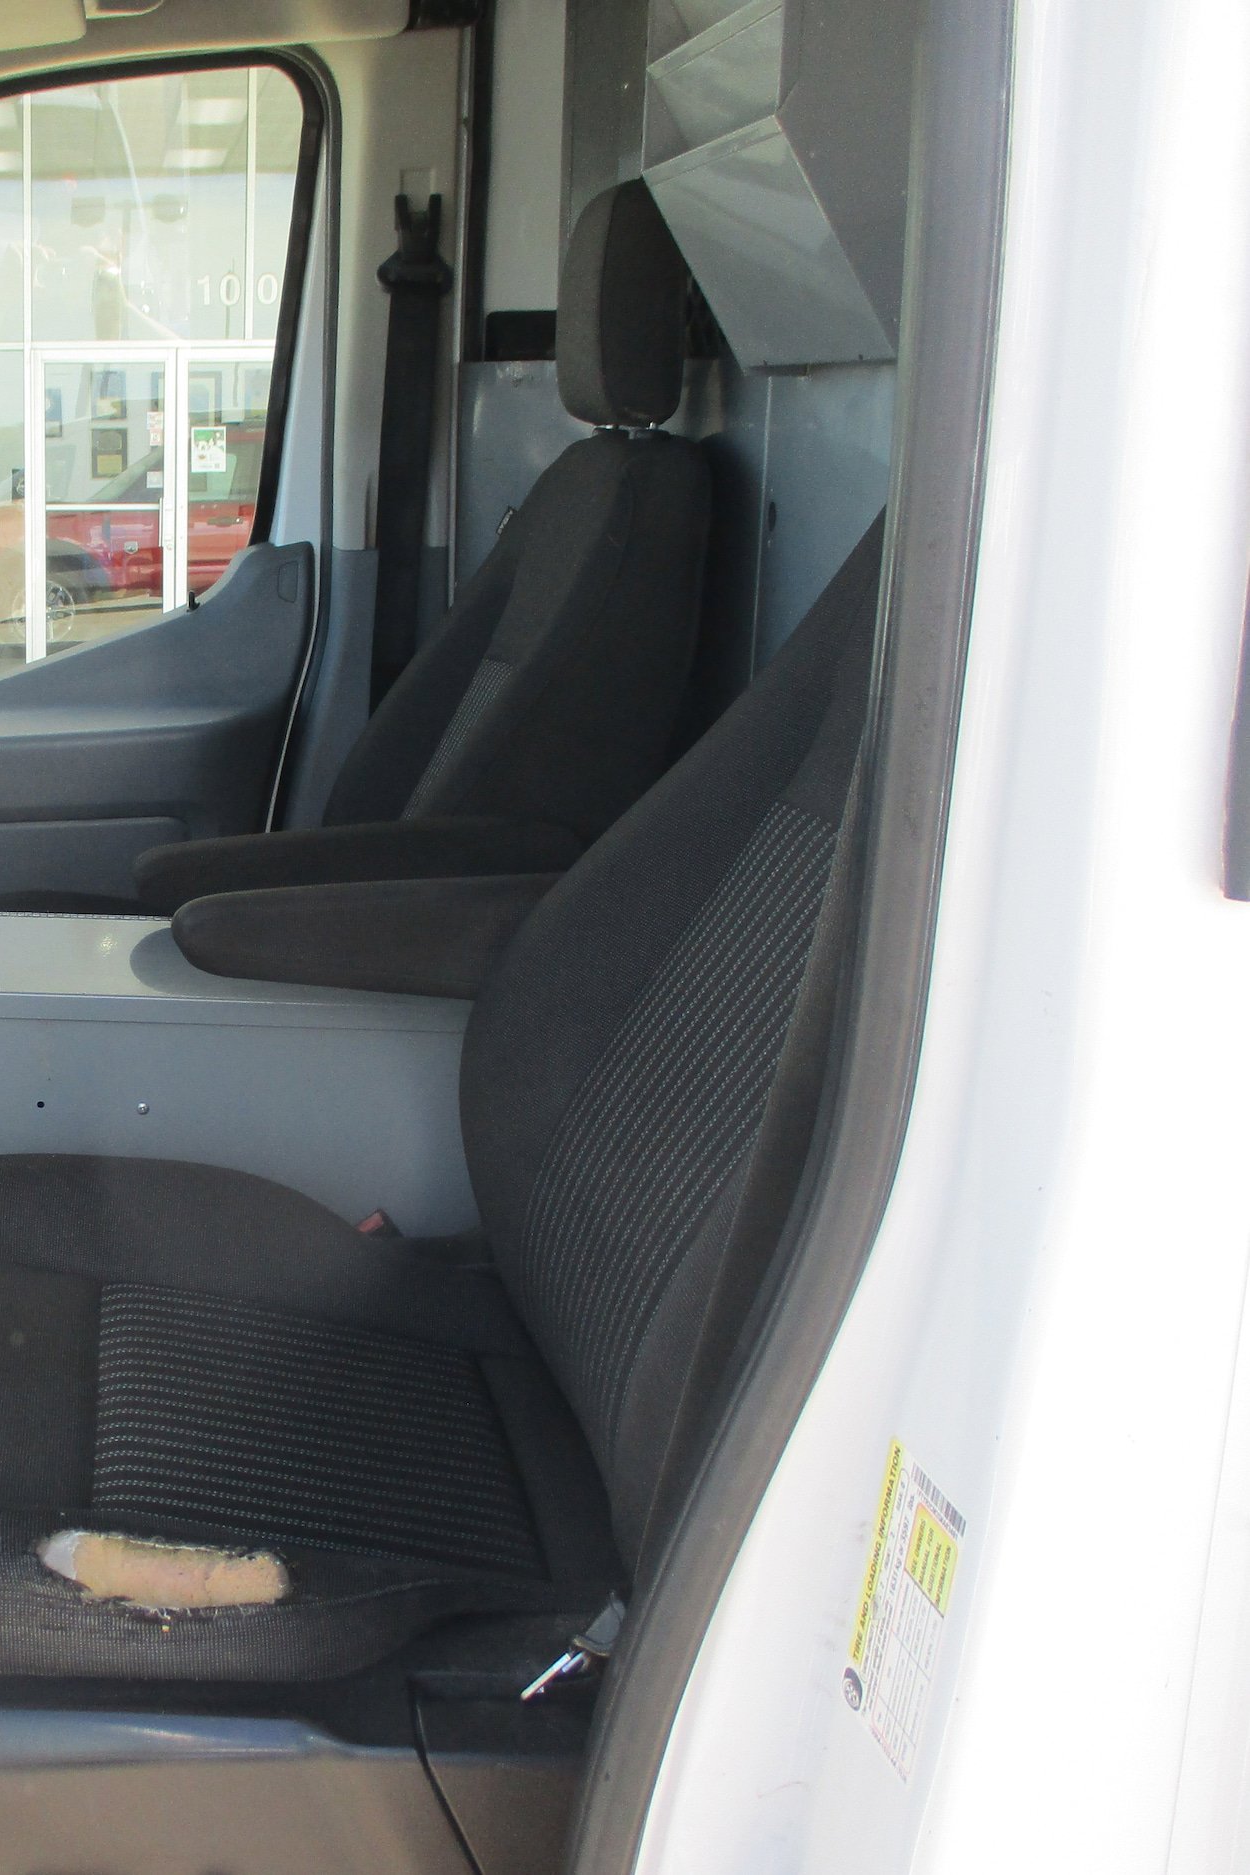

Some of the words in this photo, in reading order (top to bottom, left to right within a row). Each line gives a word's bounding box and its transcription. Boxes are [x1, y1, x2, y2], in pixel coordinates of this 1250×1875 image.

[853, 1631, 863, 1660] TIRE
[860, 1602, 869, 1629] AND
[866, 1542, 882, 1598] LOADING
[878, 1446, 901, 1538] INFORMATION
[926, 1528, 934, 1548] FOR
[927, 1543, 942, 1594] ADDITIONAL
